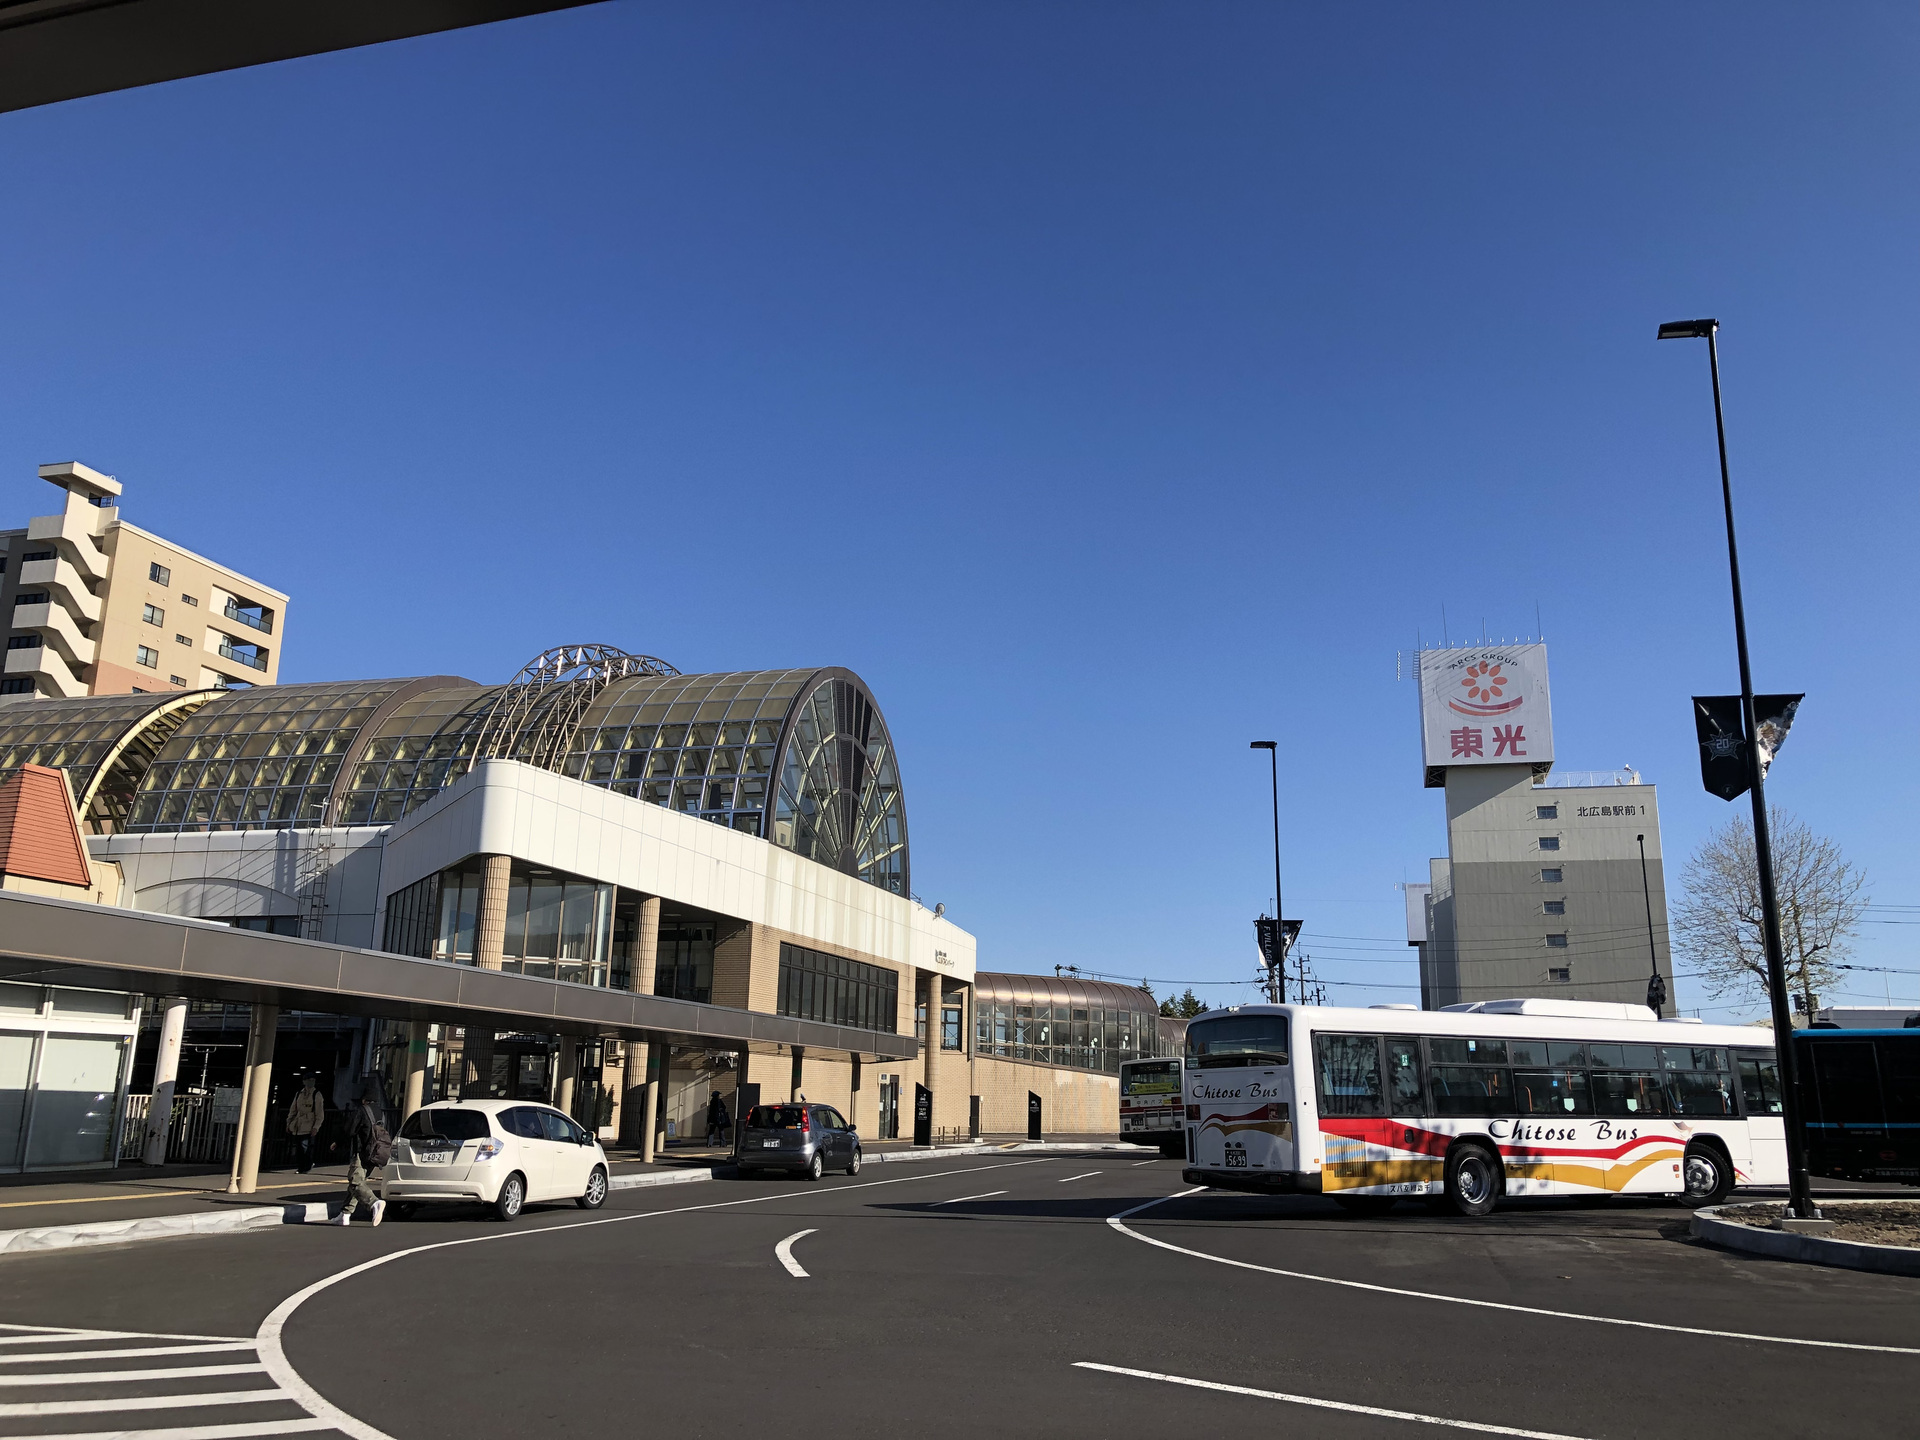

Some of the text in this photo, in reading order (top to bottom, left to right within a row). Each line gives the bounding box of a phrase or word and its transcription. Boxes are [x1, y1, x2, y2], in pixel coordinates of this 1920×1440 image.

[1450, 653, 1519, 670] ARCS GROUP
[1450, 724, 1527, 758] 東光
[1716, 738, 1729, 749] 20
[1192, 1082, 1278, 1100] Chitose Bus
[1488, 1119, 1638, 1142] Chitose Bus
